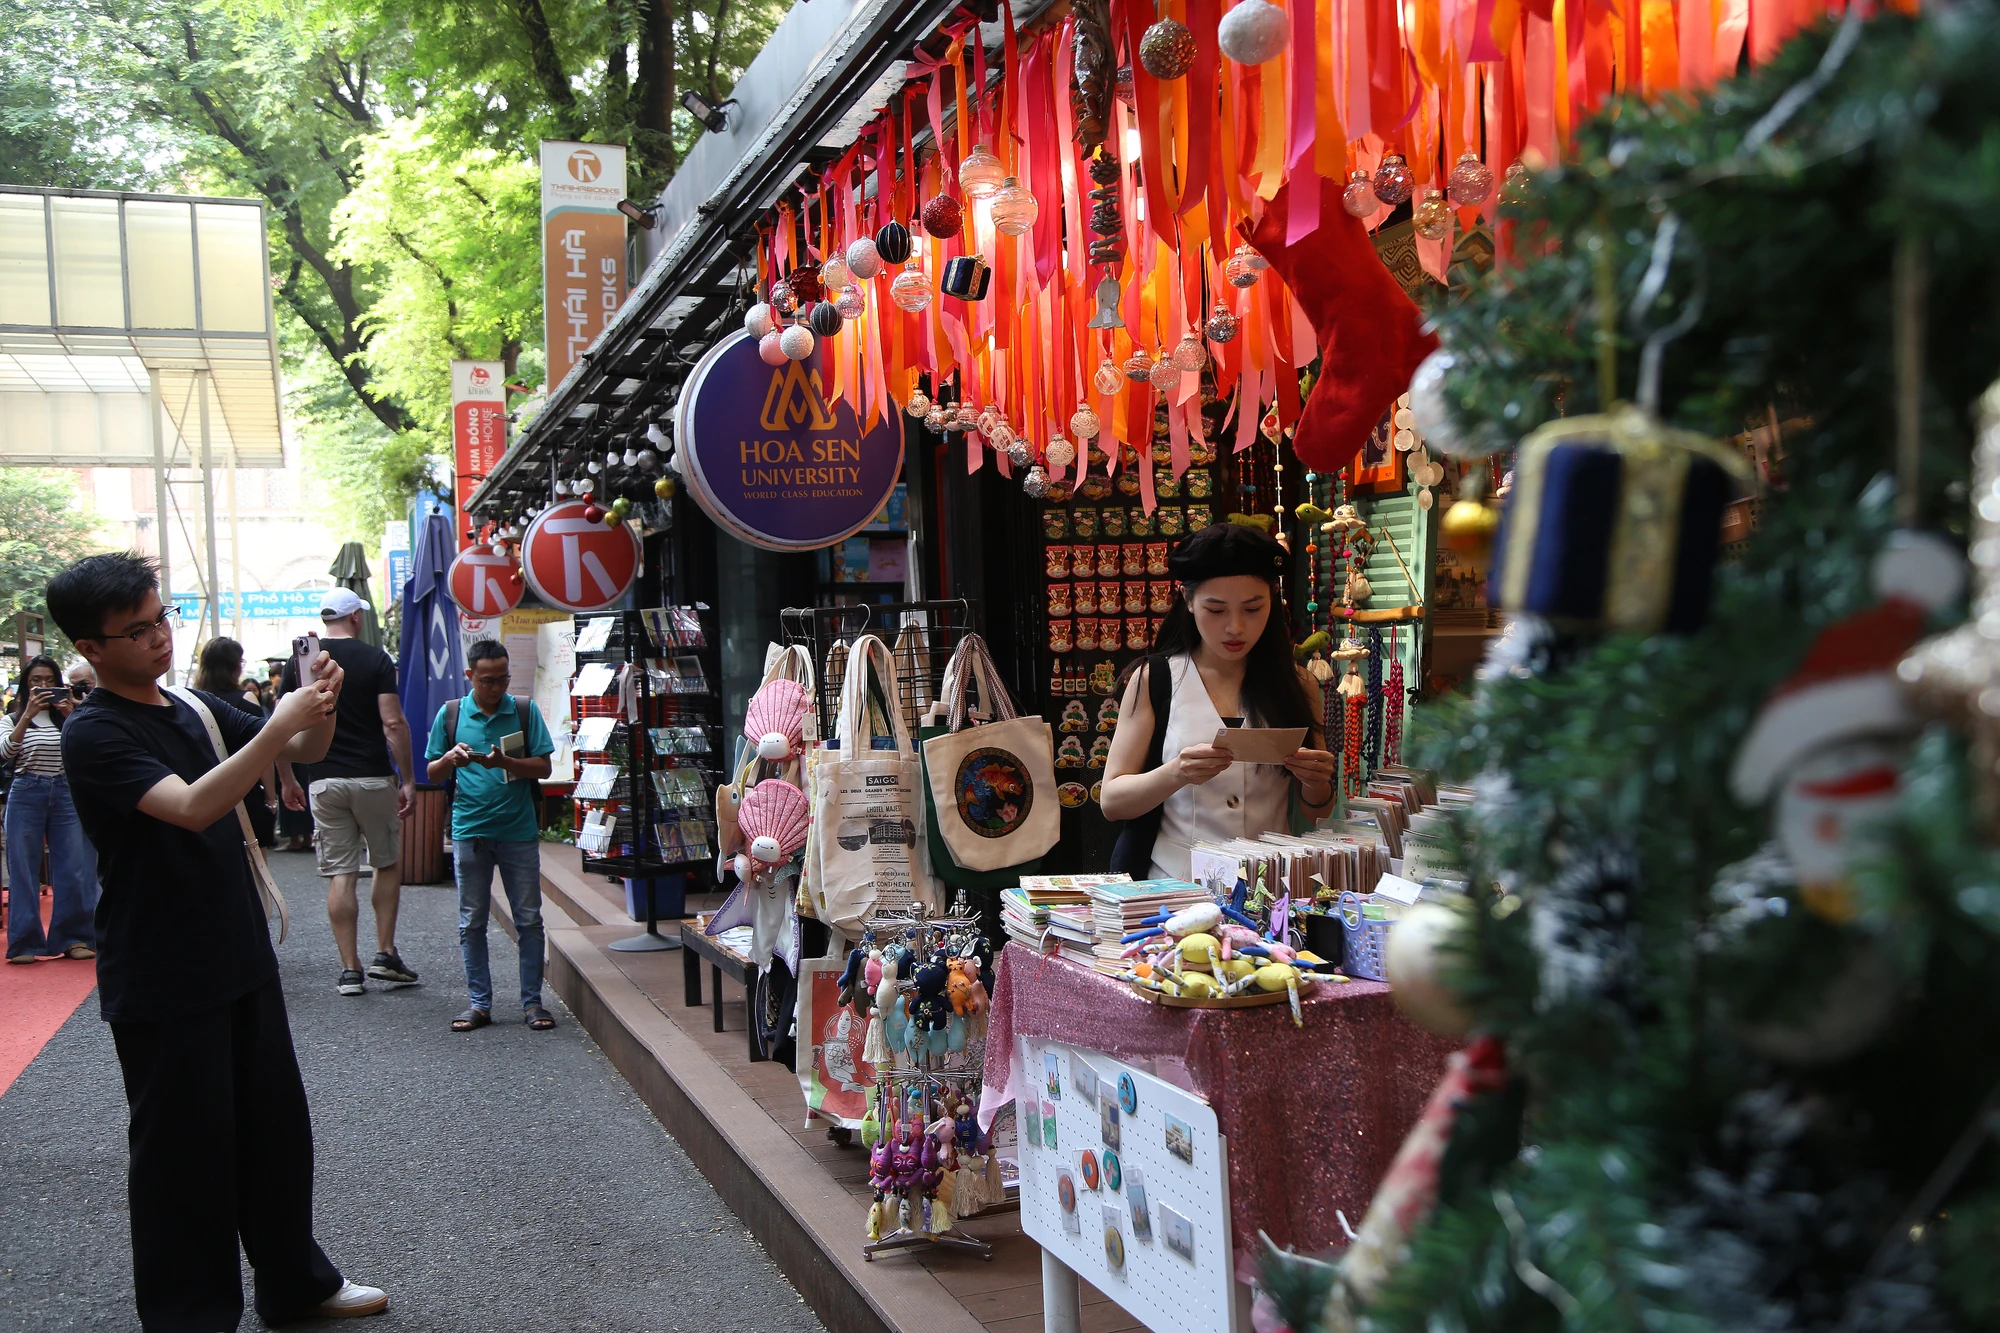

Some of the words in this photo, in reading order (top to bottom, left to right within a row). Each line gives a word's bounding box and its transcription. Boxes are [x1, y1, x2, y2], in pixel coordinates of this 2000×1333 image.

[560, 229, 587, 279] HÀ
[601, 257, 617, 327] OOKS
[482, 407, 494, 443] HOUSE
[470, 448, 480, 471] KIM
[740, 440, 804, 463] HOA
[812, 439, 861, 462] SEN
[741, 467, 861, 486] UNIVERSITY
[743, 491, 777, 499] WORLD
[781, 490, 808, 498] CLASS
[812, 488, 863, 497] EDUCATION
[253, 606, 288, 616] Book
